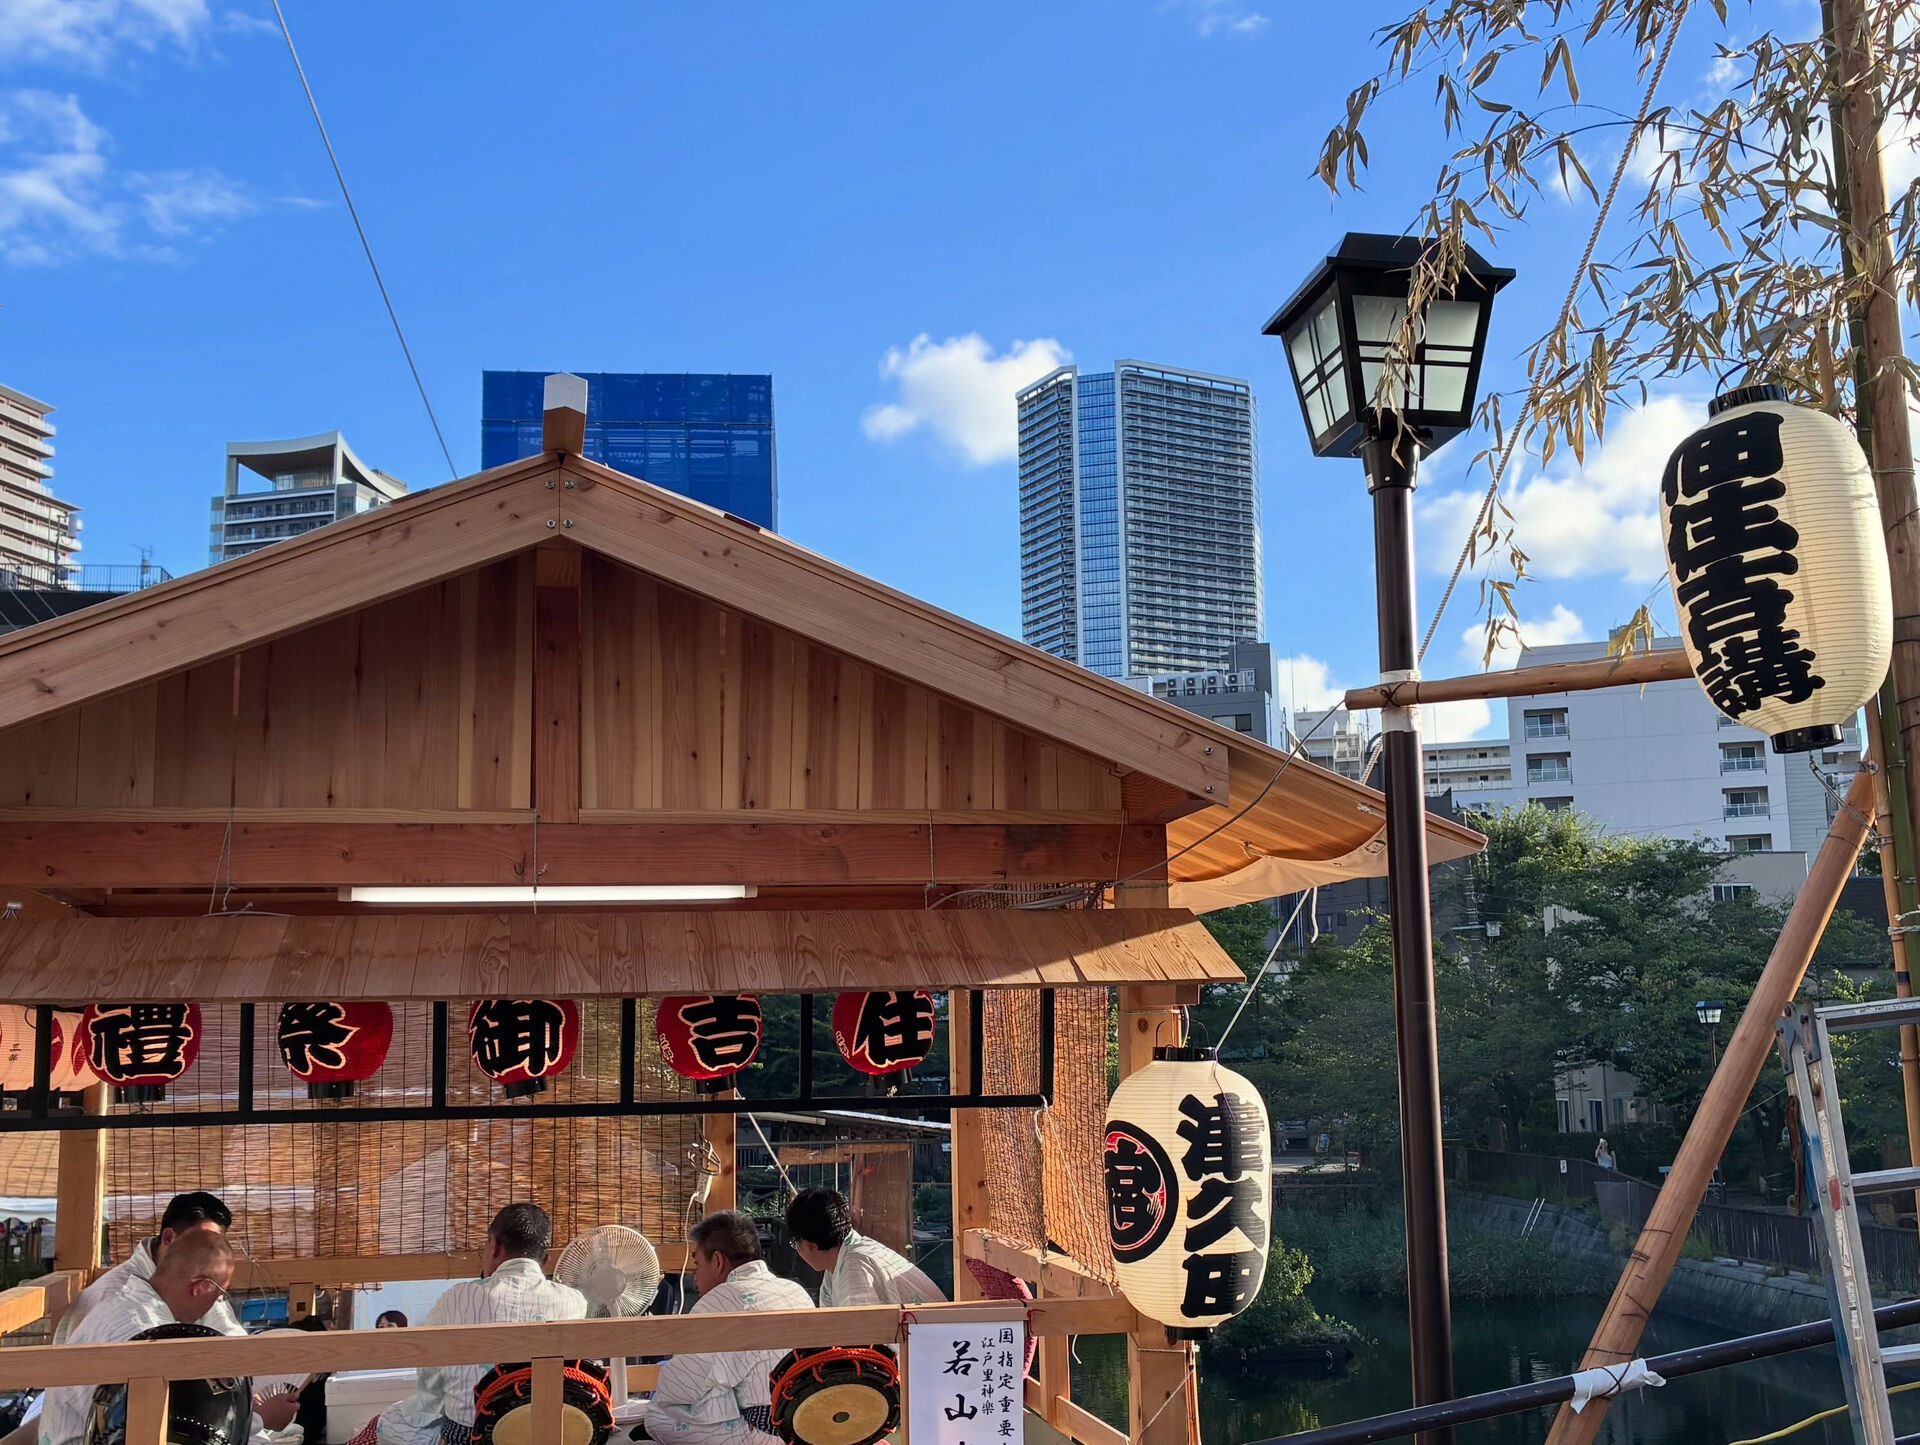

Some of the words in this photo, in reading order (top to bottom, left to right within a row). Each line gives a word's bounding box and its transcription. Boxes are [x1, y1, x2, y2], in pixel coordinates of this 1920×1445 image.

[678, 995, 762, 1071] 吉
[851, 991, 934, 1068] 住
[1176, 1092, 1265, 1318] 津久田
[942, 1340, 979, 1445] 若山
[981, 1337, 995, 1415] 江戸里神楽
[997, 1327, 1015, 1445] 国指定重要
